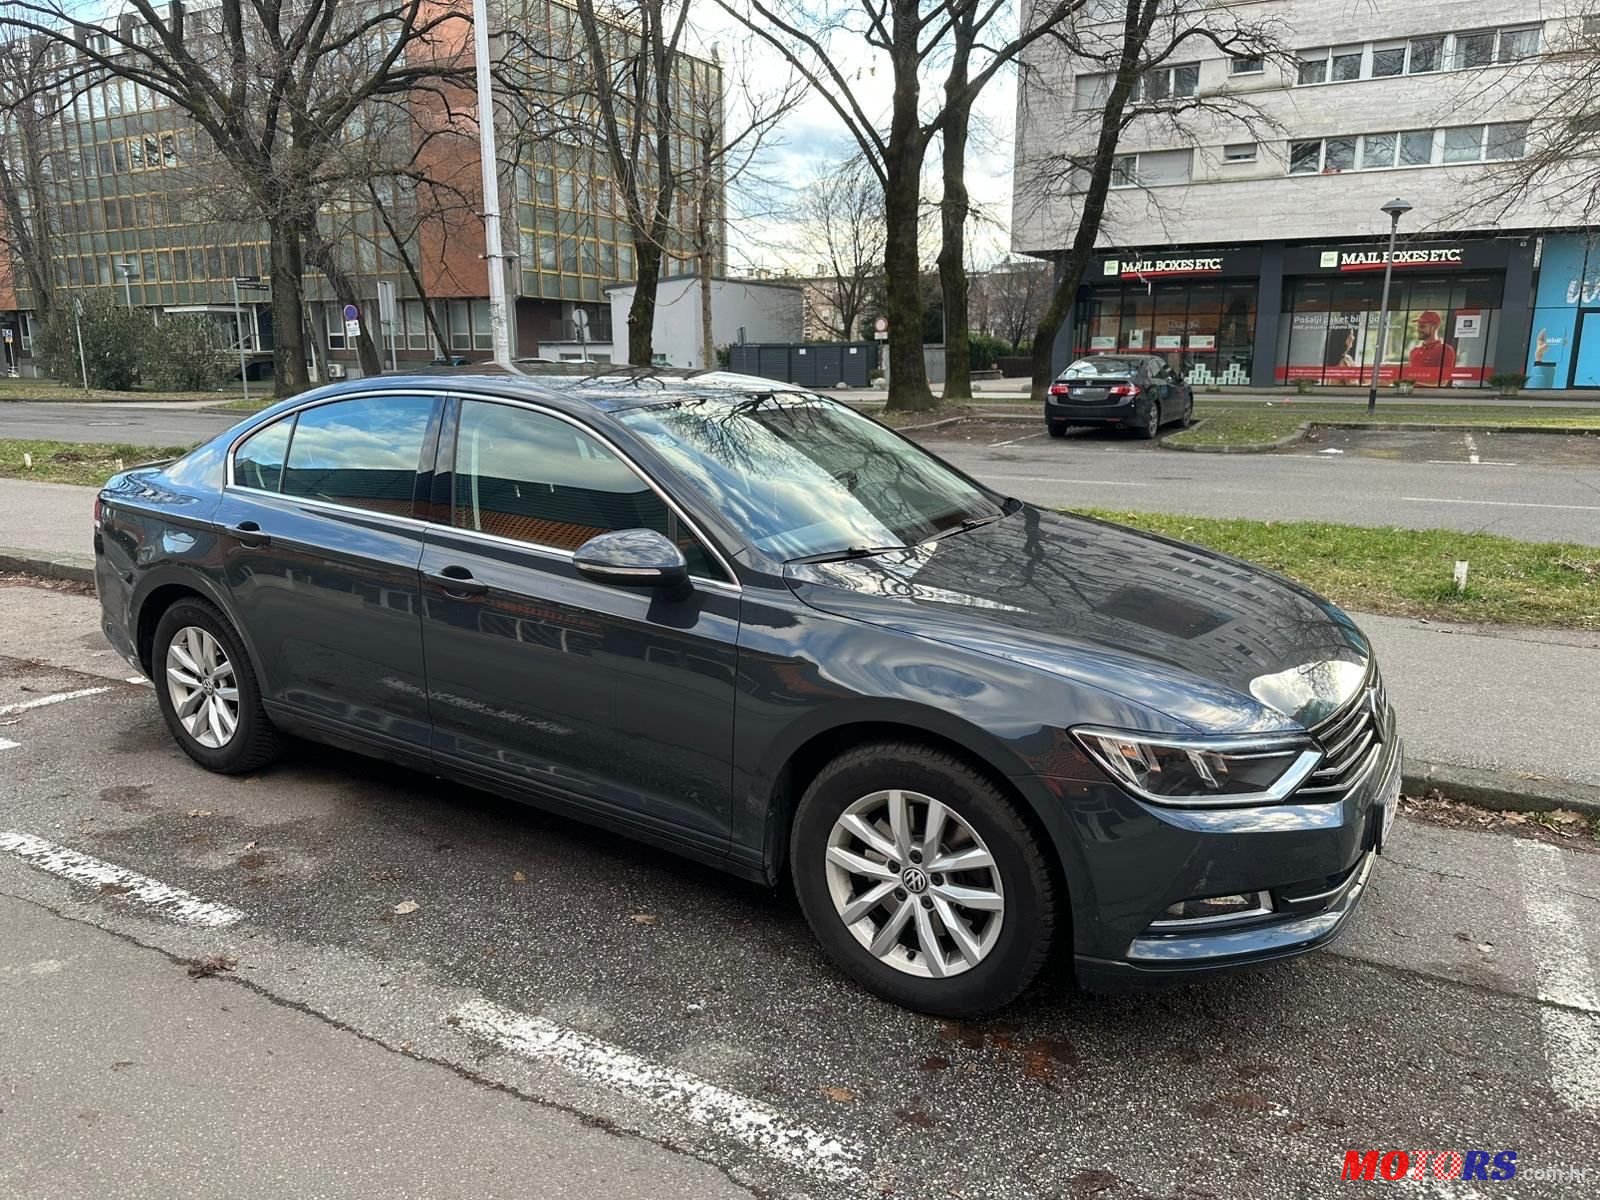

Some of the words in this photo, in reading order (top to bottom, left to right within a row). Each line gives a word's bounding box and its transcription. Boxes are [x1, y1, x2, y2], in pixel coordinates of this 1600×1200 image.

[1341, 251, 1380, 265] MAIL
[1121, 261, 1154, 273] MAIL
[1156, 260, 1194, 271] BOXES
